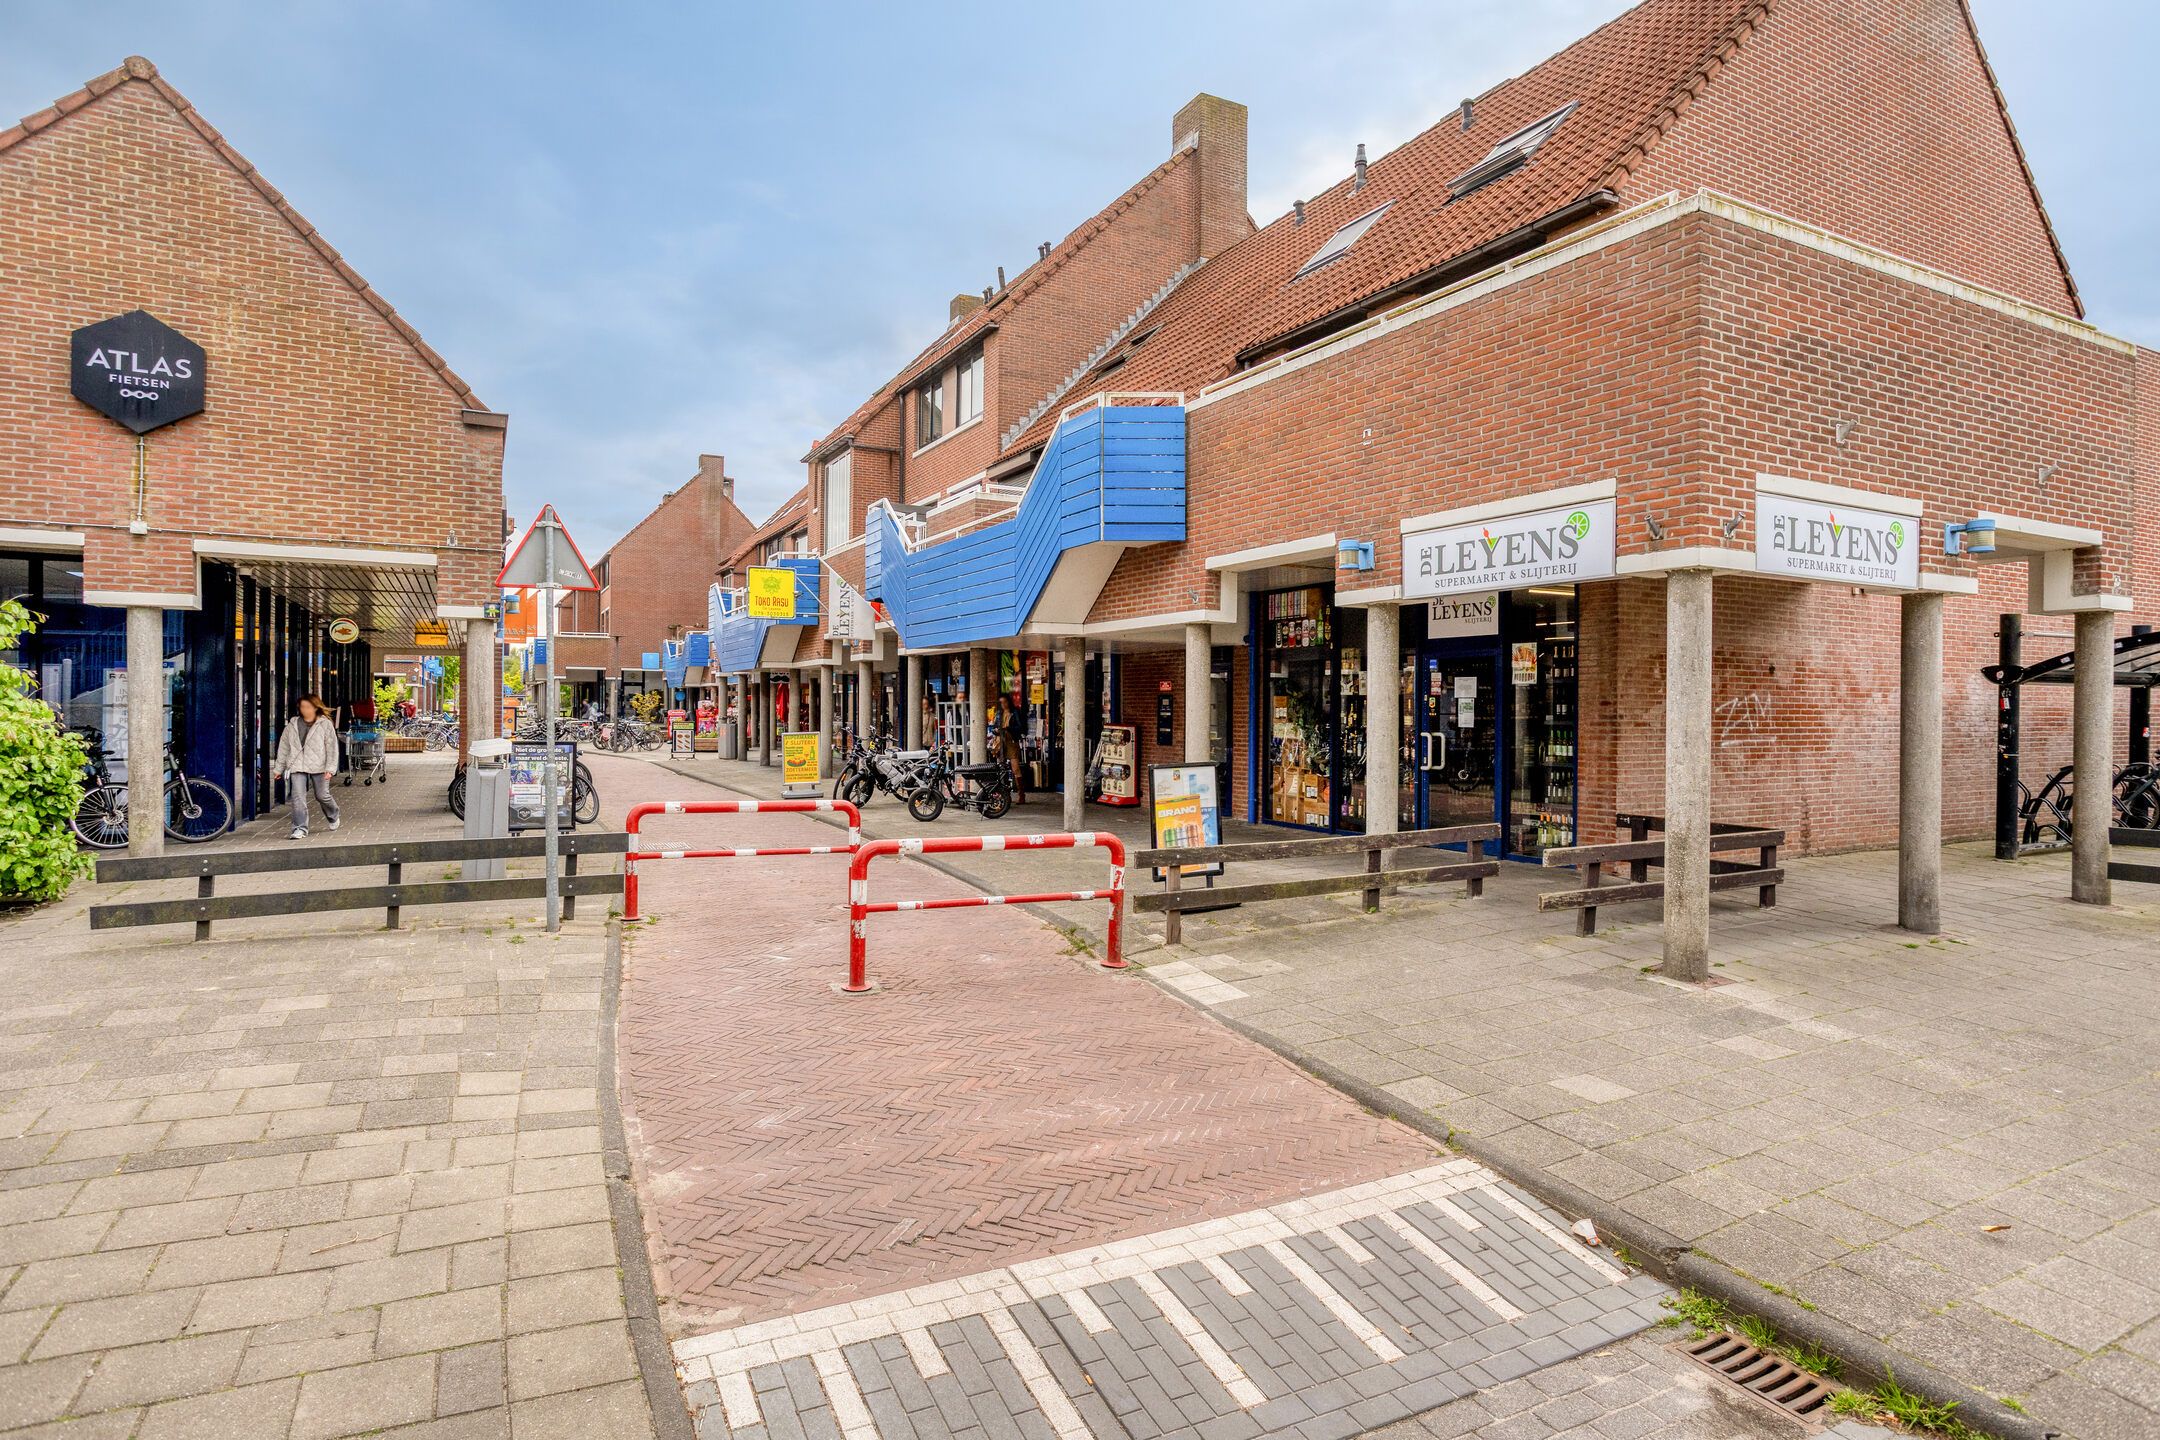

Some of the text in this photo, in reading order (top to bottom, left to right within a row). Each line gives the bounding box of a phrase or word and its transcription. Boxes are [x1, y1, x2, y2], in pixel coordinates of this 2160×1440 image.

[86, 348, 192, 379] ATLAS
[109, 373, 170, 389] FIETSEN
[1774, 515, 1785, 550] DE
[1787, 516, 1898, 565] LEYENS
[1420, 546, 1432, 577] DE
[1434, 524, 1579, 576] LEYENS
[1434, 562, 1578, 588] SUPERMARKT & SLIJTERIJ
[1787, 557, 1897, 582] SUPERMARKT & SLIJTERIJ
[754, 595, 789, 607] TOKO RASU
[1432, 600, 1492, 620] LEYENS
